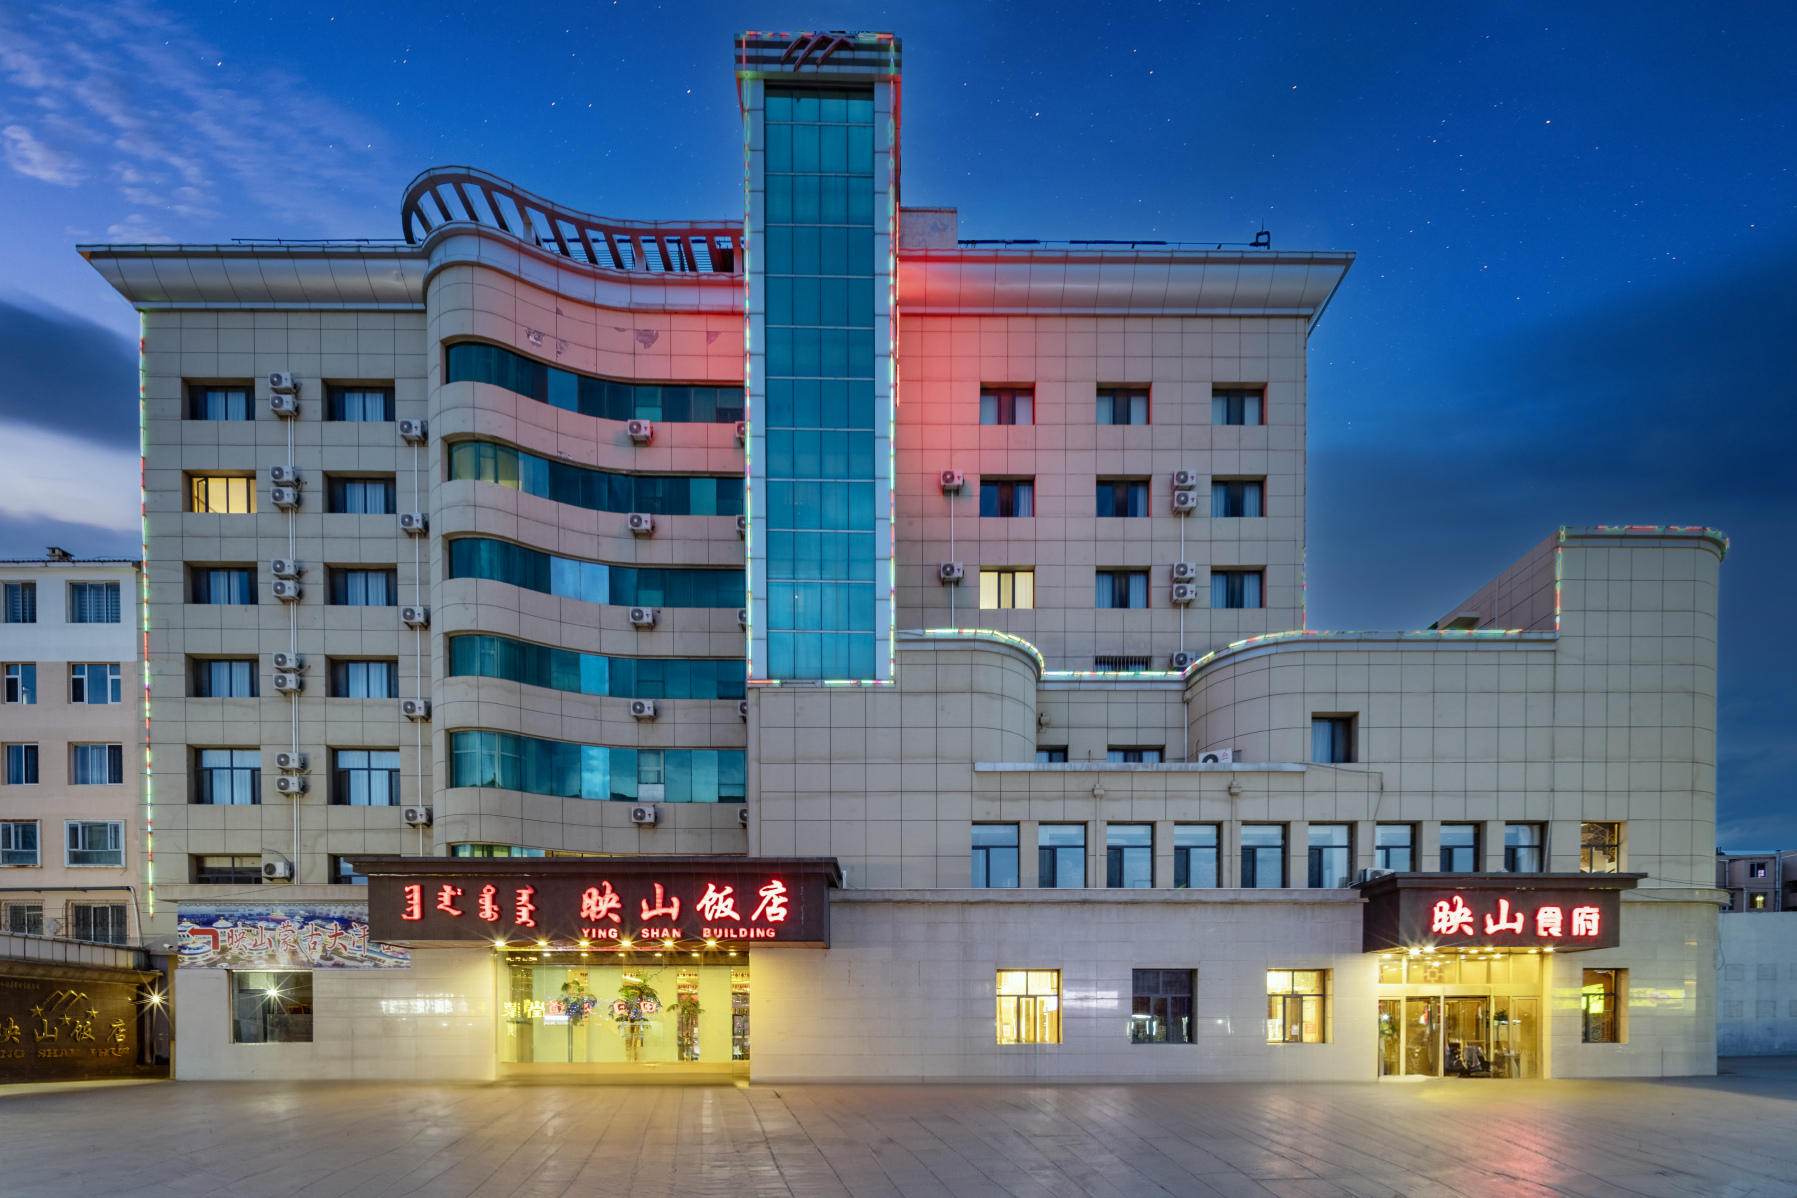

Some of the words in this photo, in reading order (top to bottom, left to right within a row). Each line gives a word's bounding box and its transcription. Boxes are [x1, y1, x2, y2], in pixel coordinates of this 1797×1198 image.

[580, 880, 790, 924] 映山饭店
[1431, 895, 1600, 937] 映山食府
[581, 927, 619, 940] YING
[641, 927, 682, 939] SHAN
[702, 927, 776, 939] BUILDING
